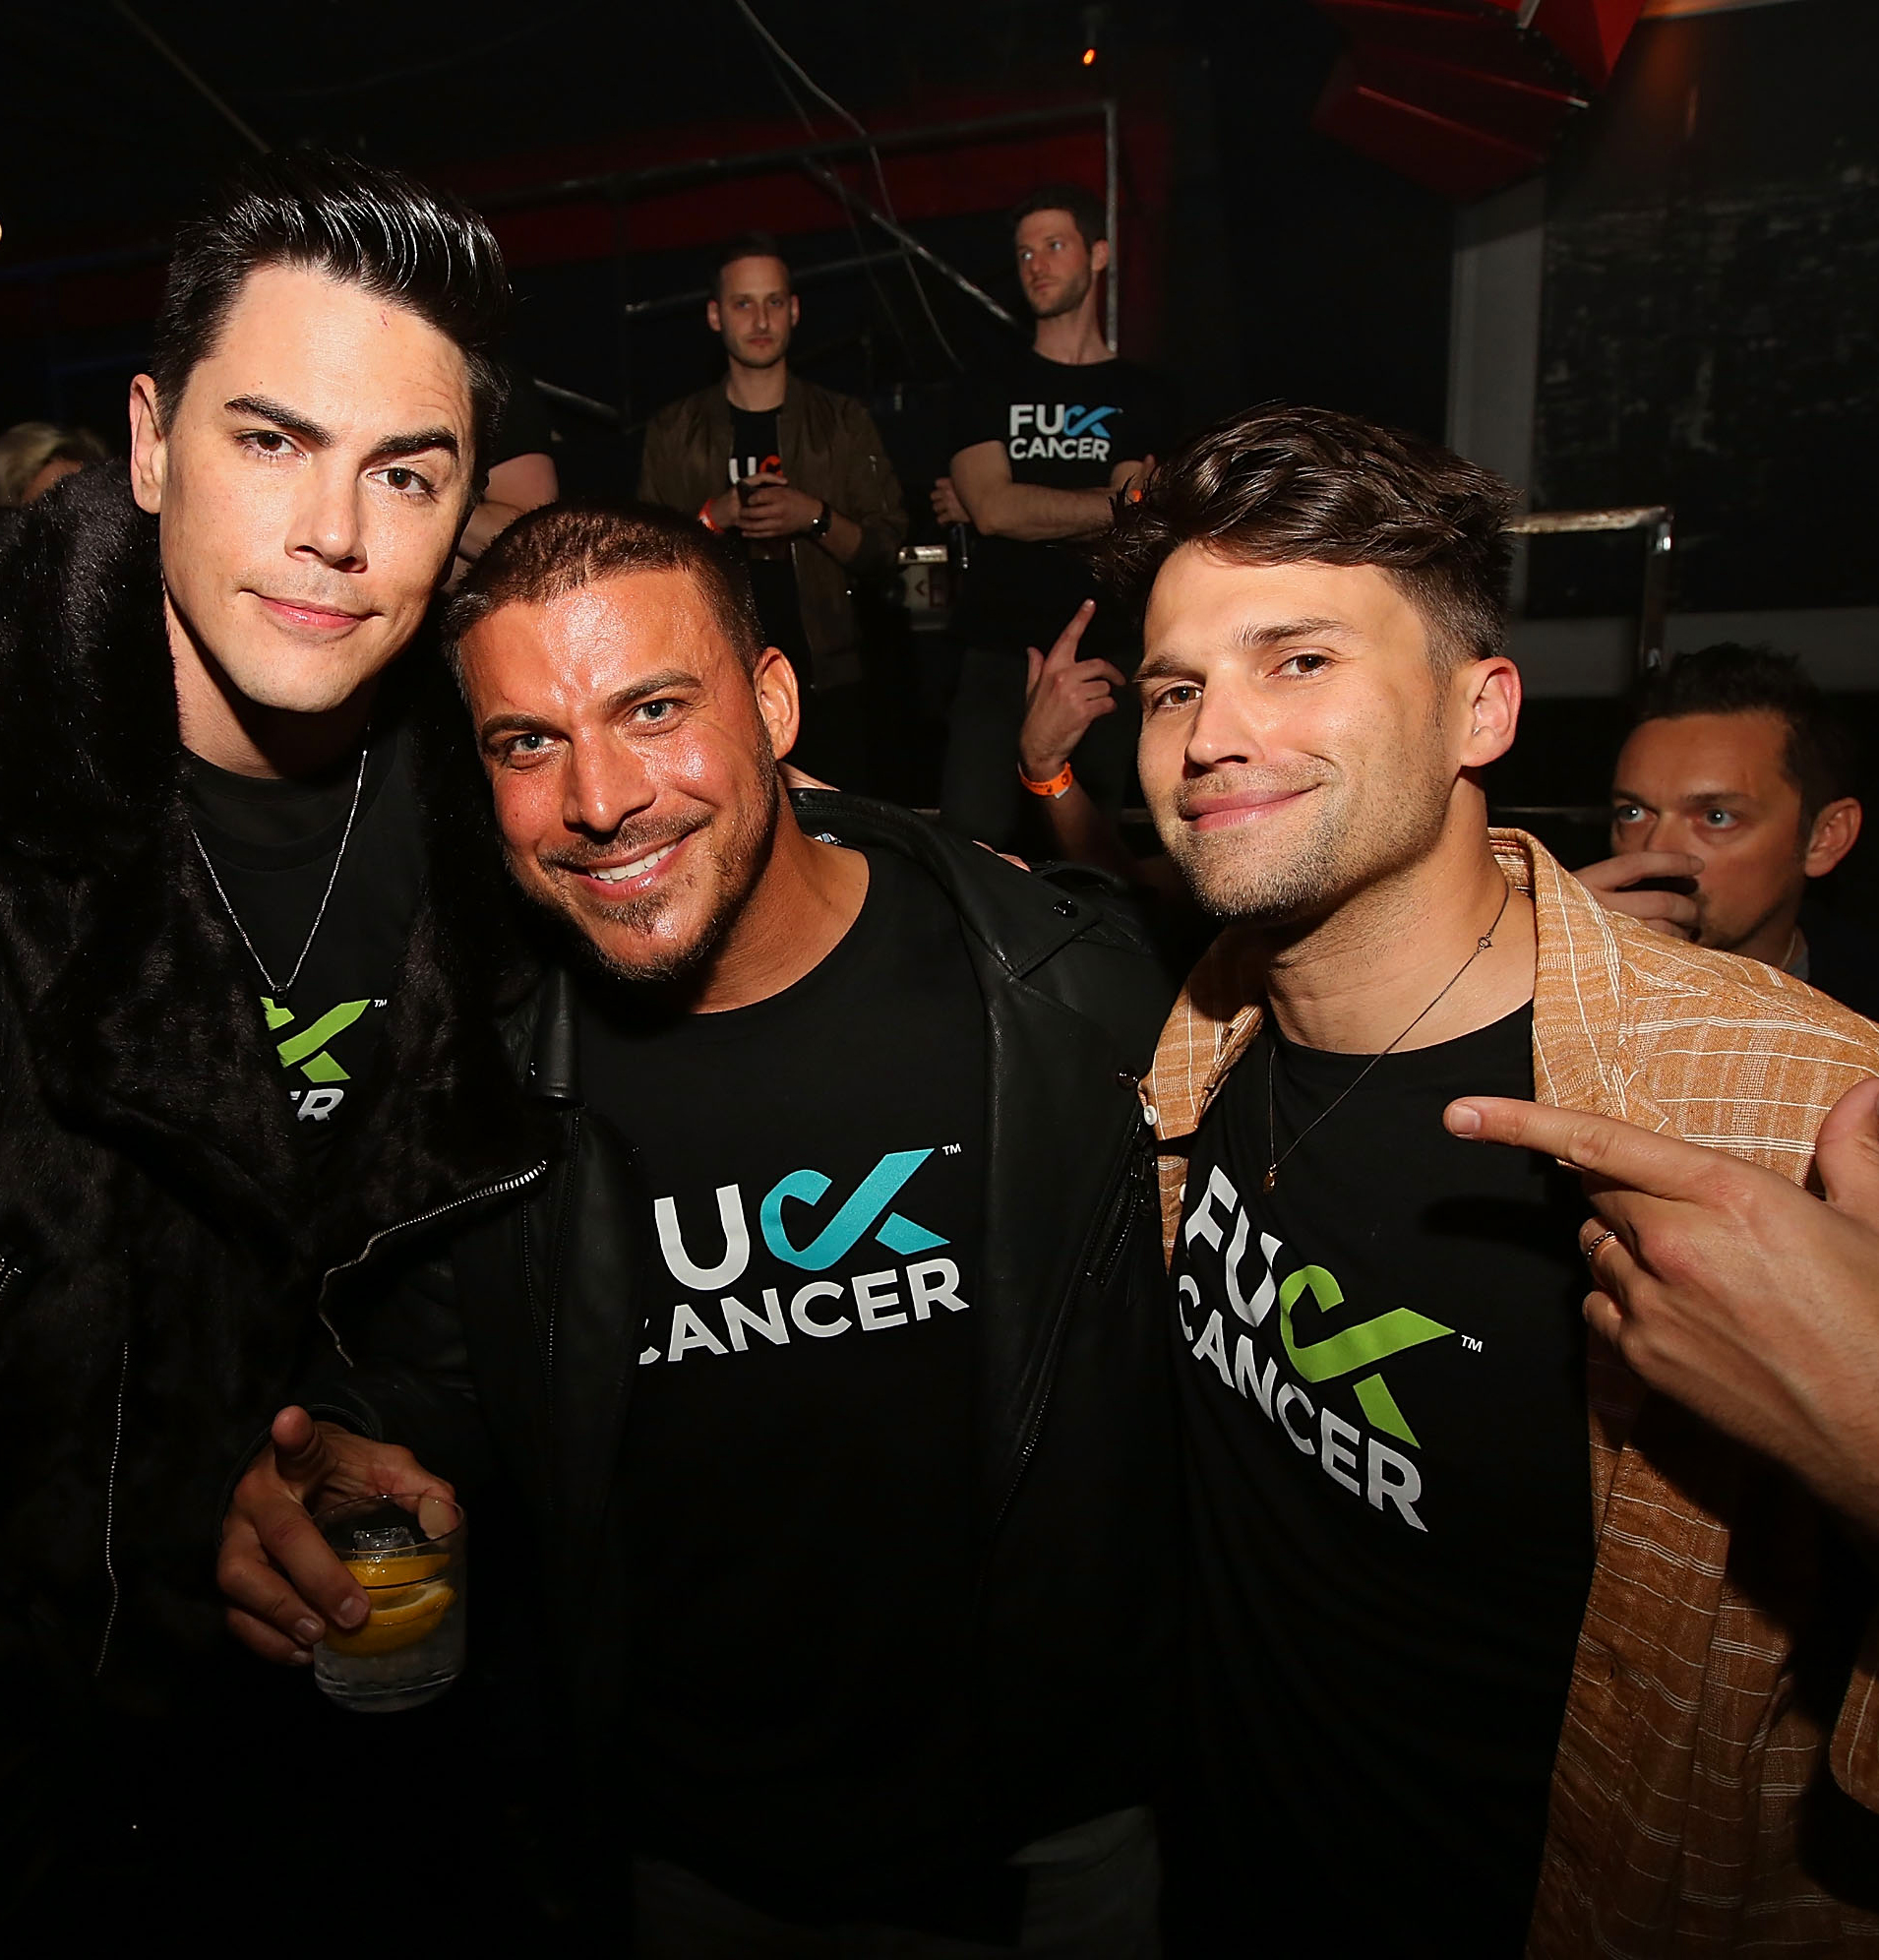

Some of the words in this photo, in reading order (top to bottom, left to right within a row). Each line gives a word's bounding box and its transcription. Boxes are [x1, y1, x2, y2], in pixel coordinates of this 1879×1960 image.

[1009, 436, 1111, 462] CANCER
[941, 1143, 962, 1156] TM
[638, 1257, 970, 1366] ANCER
[1461, 1334, 1484, 1353] TM
